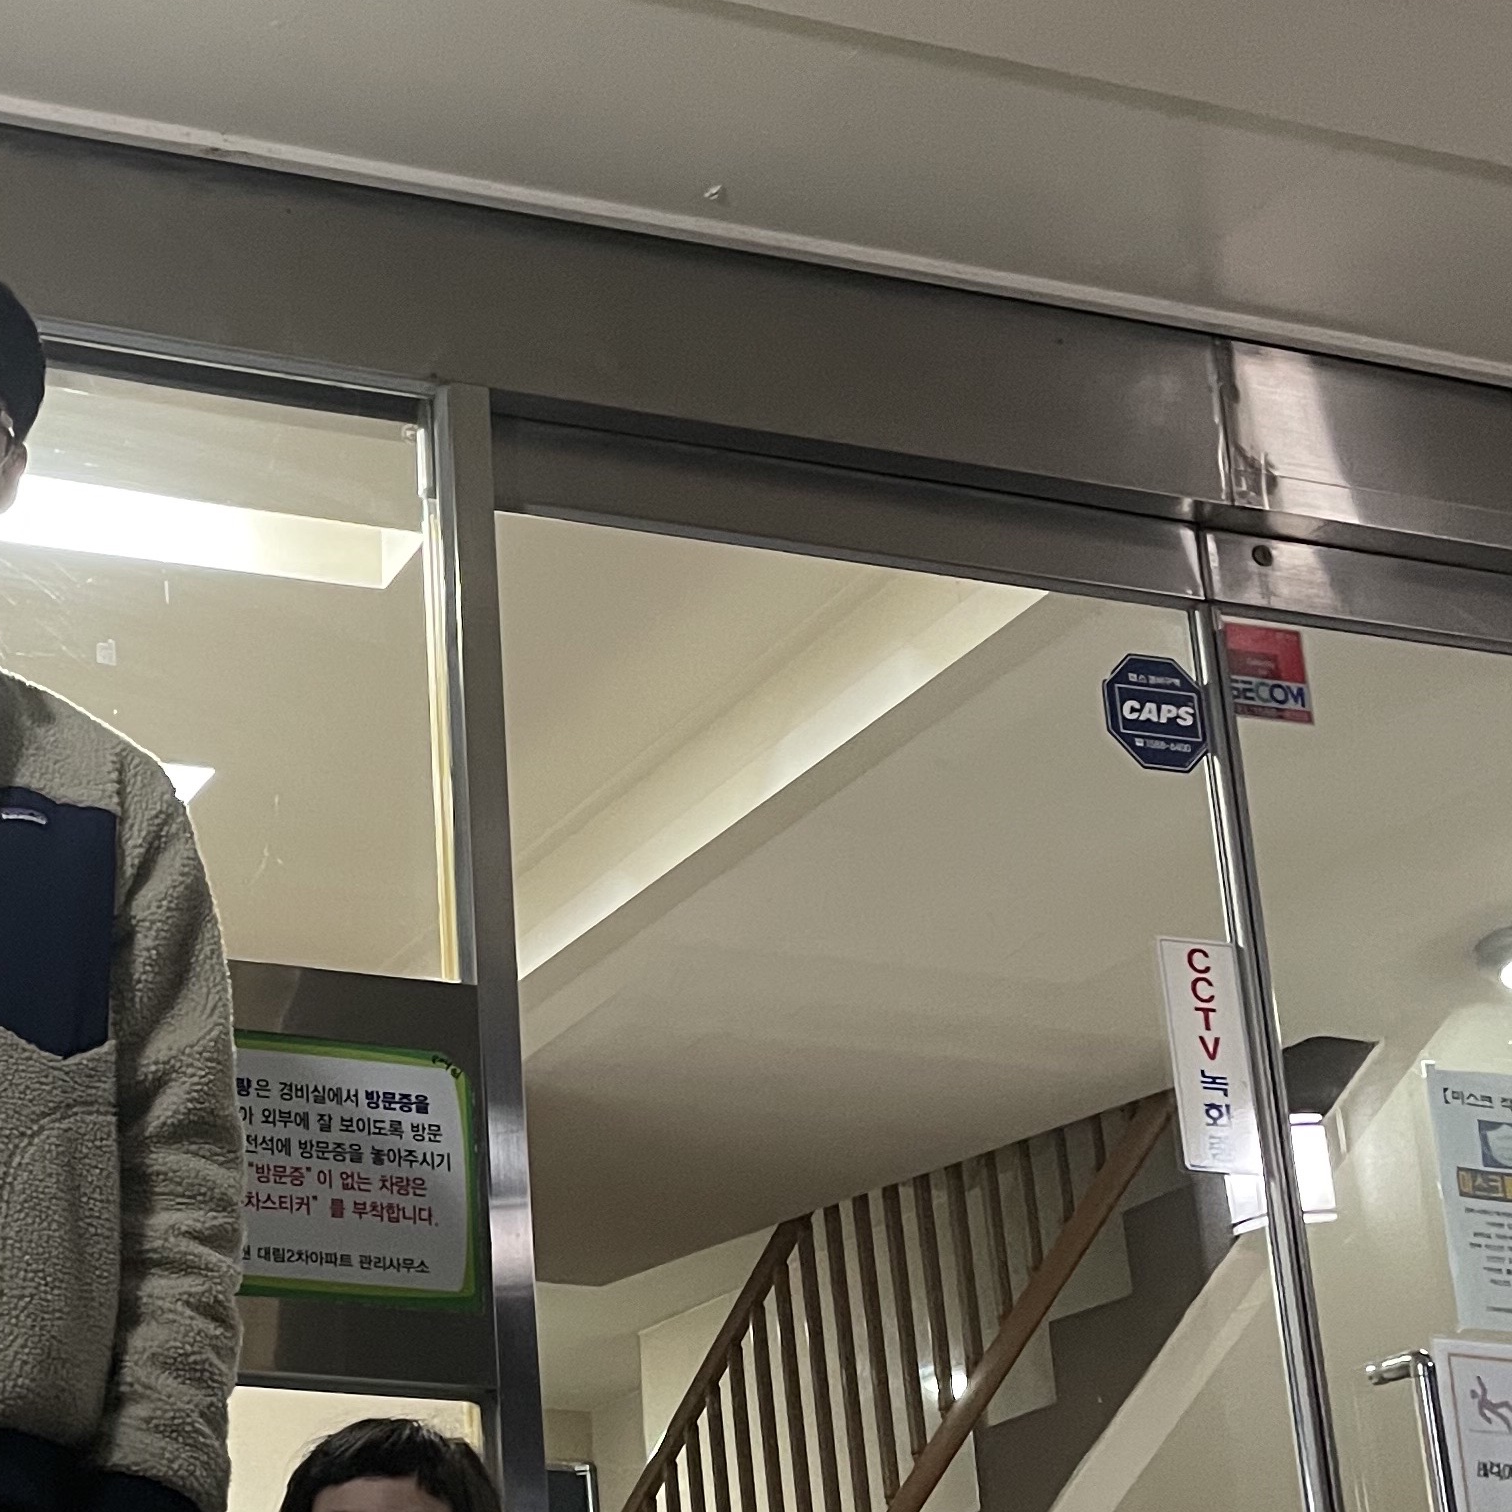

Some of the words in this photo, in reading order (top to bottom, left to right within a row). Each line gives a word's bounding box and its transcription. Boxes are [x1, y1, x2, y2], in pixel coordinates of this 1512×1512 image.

[1122, 699, 1195, 726] CAPS
[1187, 948, 1221, 1061] CCTV
[279, 1081, 359, 1108] 경비실에서
[364, 1089, 430, 1115] 방문증을
[260, 1107, 310, 1131] 외부에
[316, 1112, 333, 1133] 잘
[338, 1115, 405, 1141] 보이도록
[410, 1121, 443, 1144] 방문
[297, 1139, 365, 1164] 방문증을
[369, 1144, 451, 1172] 놓아주시기
[339, 1171, 374, 1193] 없는
[378, 1175, 429, 1198] 차량은
[241, 1191, 319, 1216] 차스티커"
[352, 1201, 439, 1228] 부착합니다.
[257, 1245, 354, 1268] 대림2차아파트
[359, 1253, 431, 1275] 관리사무소
